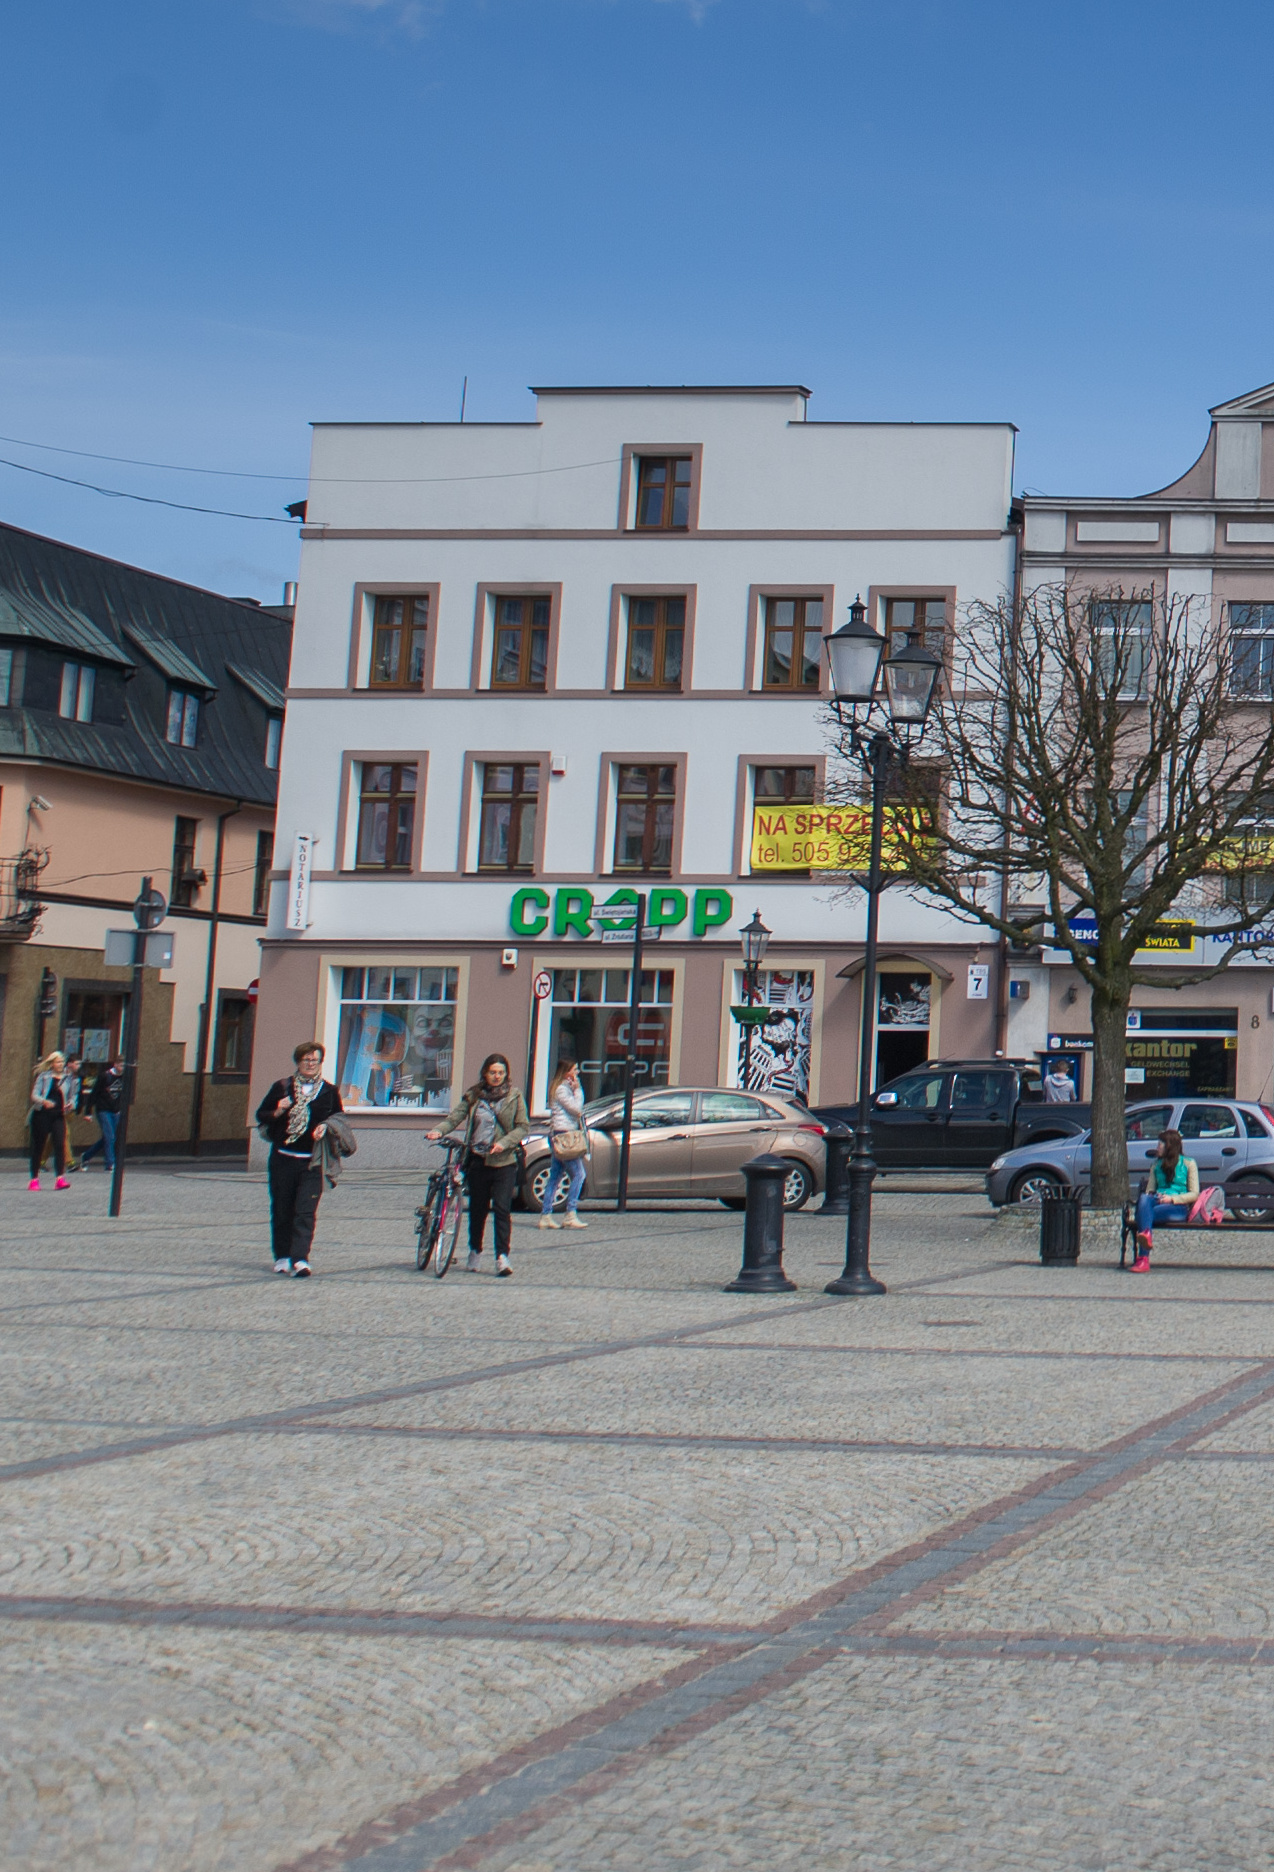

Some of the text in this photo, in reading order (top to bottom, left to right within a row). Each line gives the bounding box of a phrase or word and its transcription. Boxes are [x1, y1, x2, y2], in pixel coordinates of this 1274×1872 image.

[758, 814, 788, 835] NA
[758, 843, 785, 863] tel.
[792, 842, 830, 862] 505
[295, 844, 306, 927] NOTARIUSZ
[510, 888, 733, 937] CROPP
[974, 977, 982, 991] 7
[1251, 1014, 1260, 1029] 8
